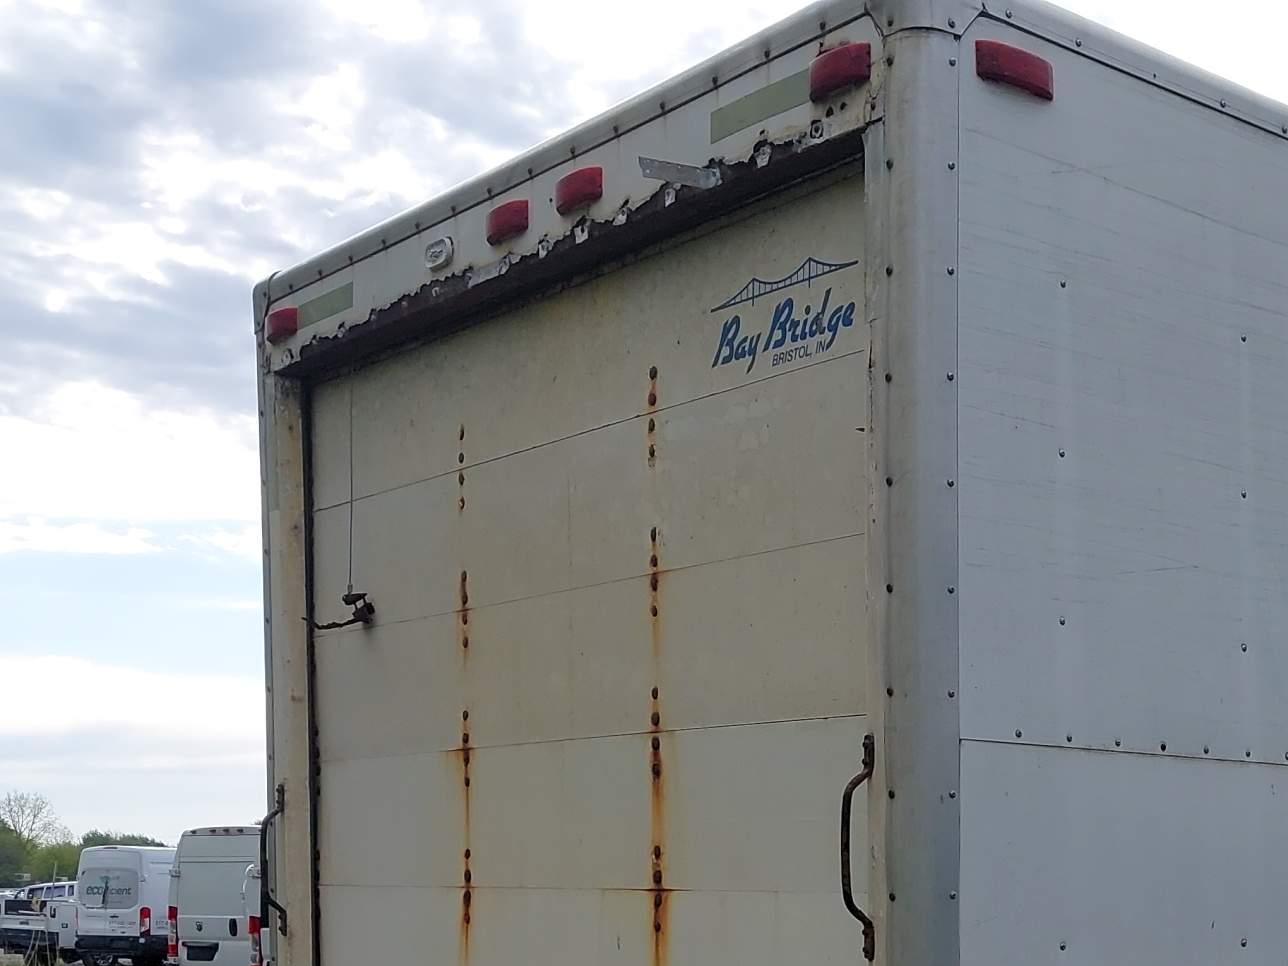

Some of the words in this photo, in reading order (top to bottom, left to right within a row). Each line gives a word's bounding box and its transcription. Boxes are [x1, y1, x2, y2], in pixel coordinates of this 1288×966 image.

[711, 315, 762, 374] Bay
[763, 287, 856, 352] Bridge
[771, 344, 812, 367] BRISTOL,
